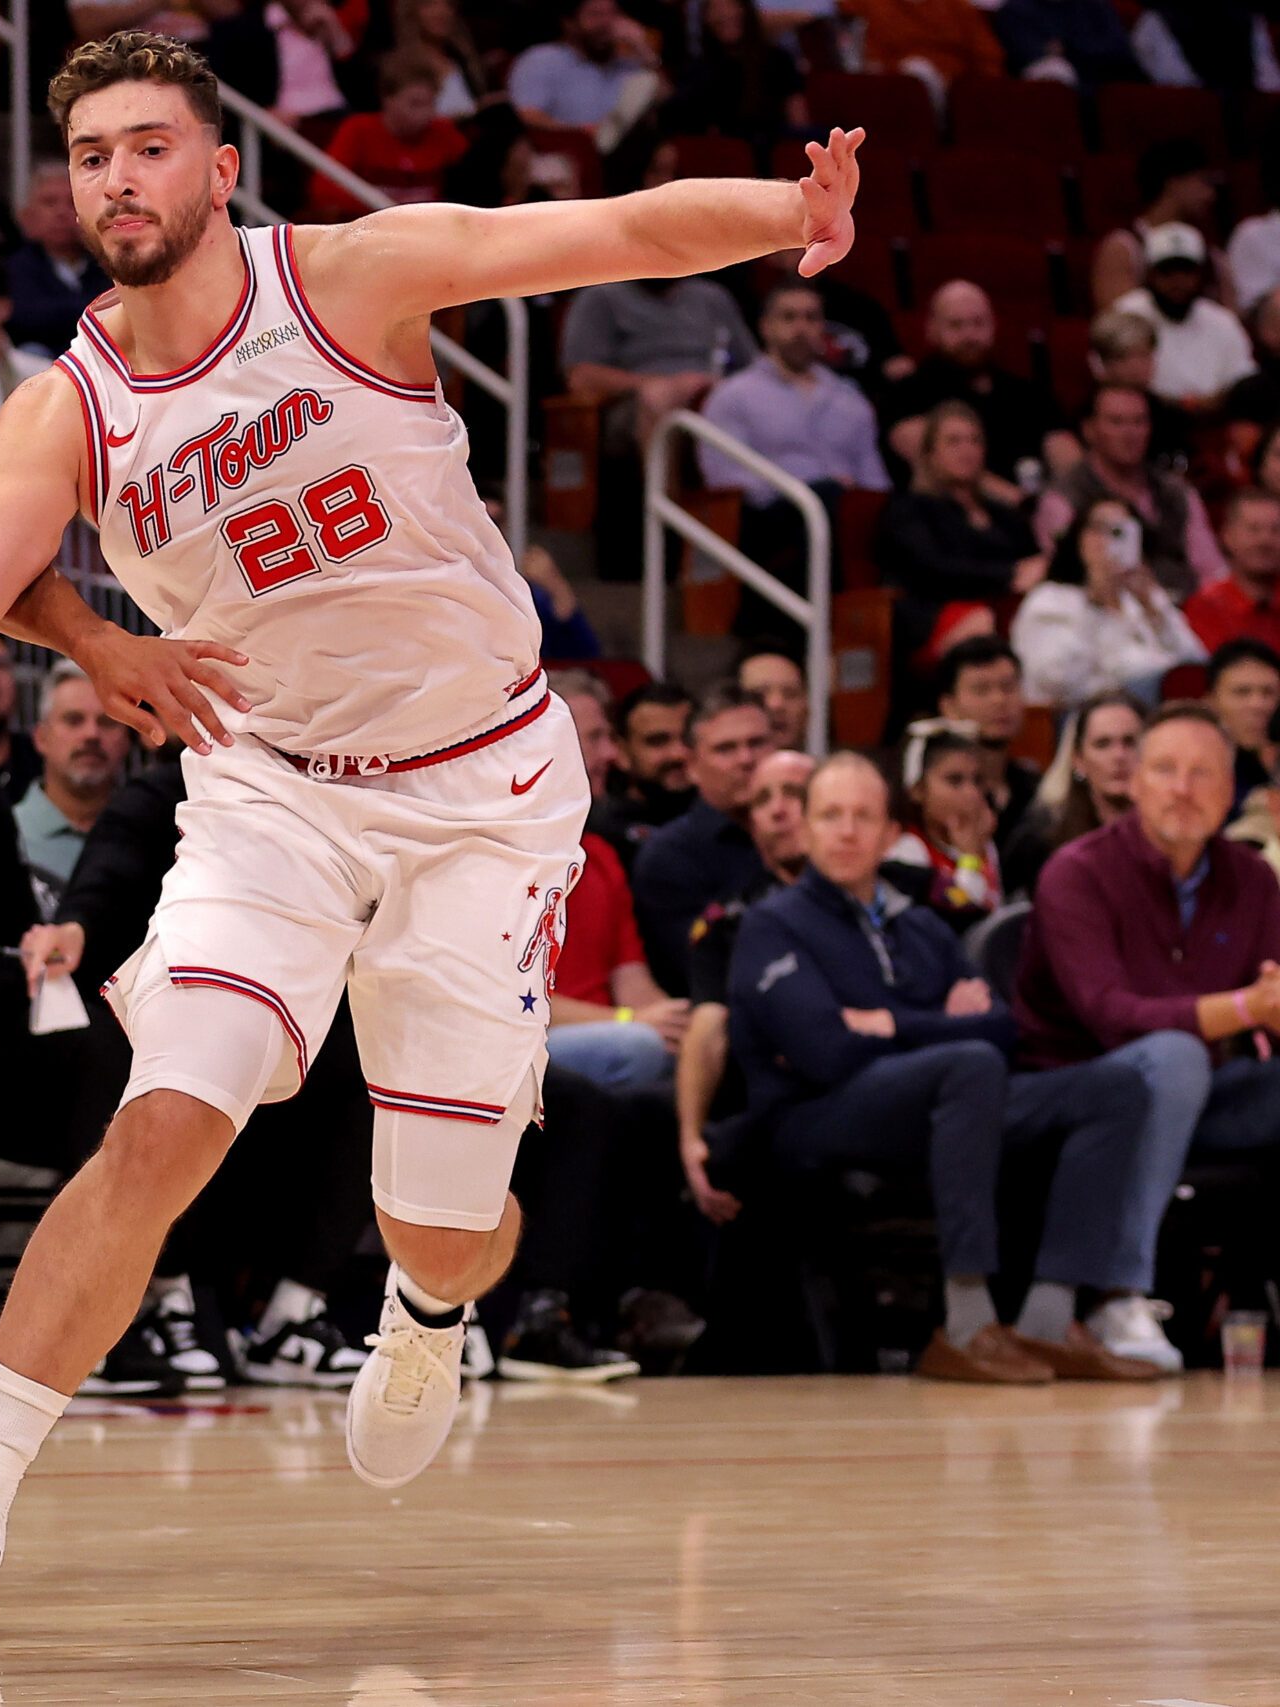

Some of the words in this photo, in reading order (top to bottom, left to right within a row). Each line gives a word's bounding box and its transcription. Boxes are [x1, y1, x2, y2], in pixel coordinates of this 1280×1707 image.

[235, 321, 298, 356] MEMORIAL
[236, 328, 300, 365] HERMANN
[117, 388, 334, 557] H-Town
[220, 463, 392, 598] 28
